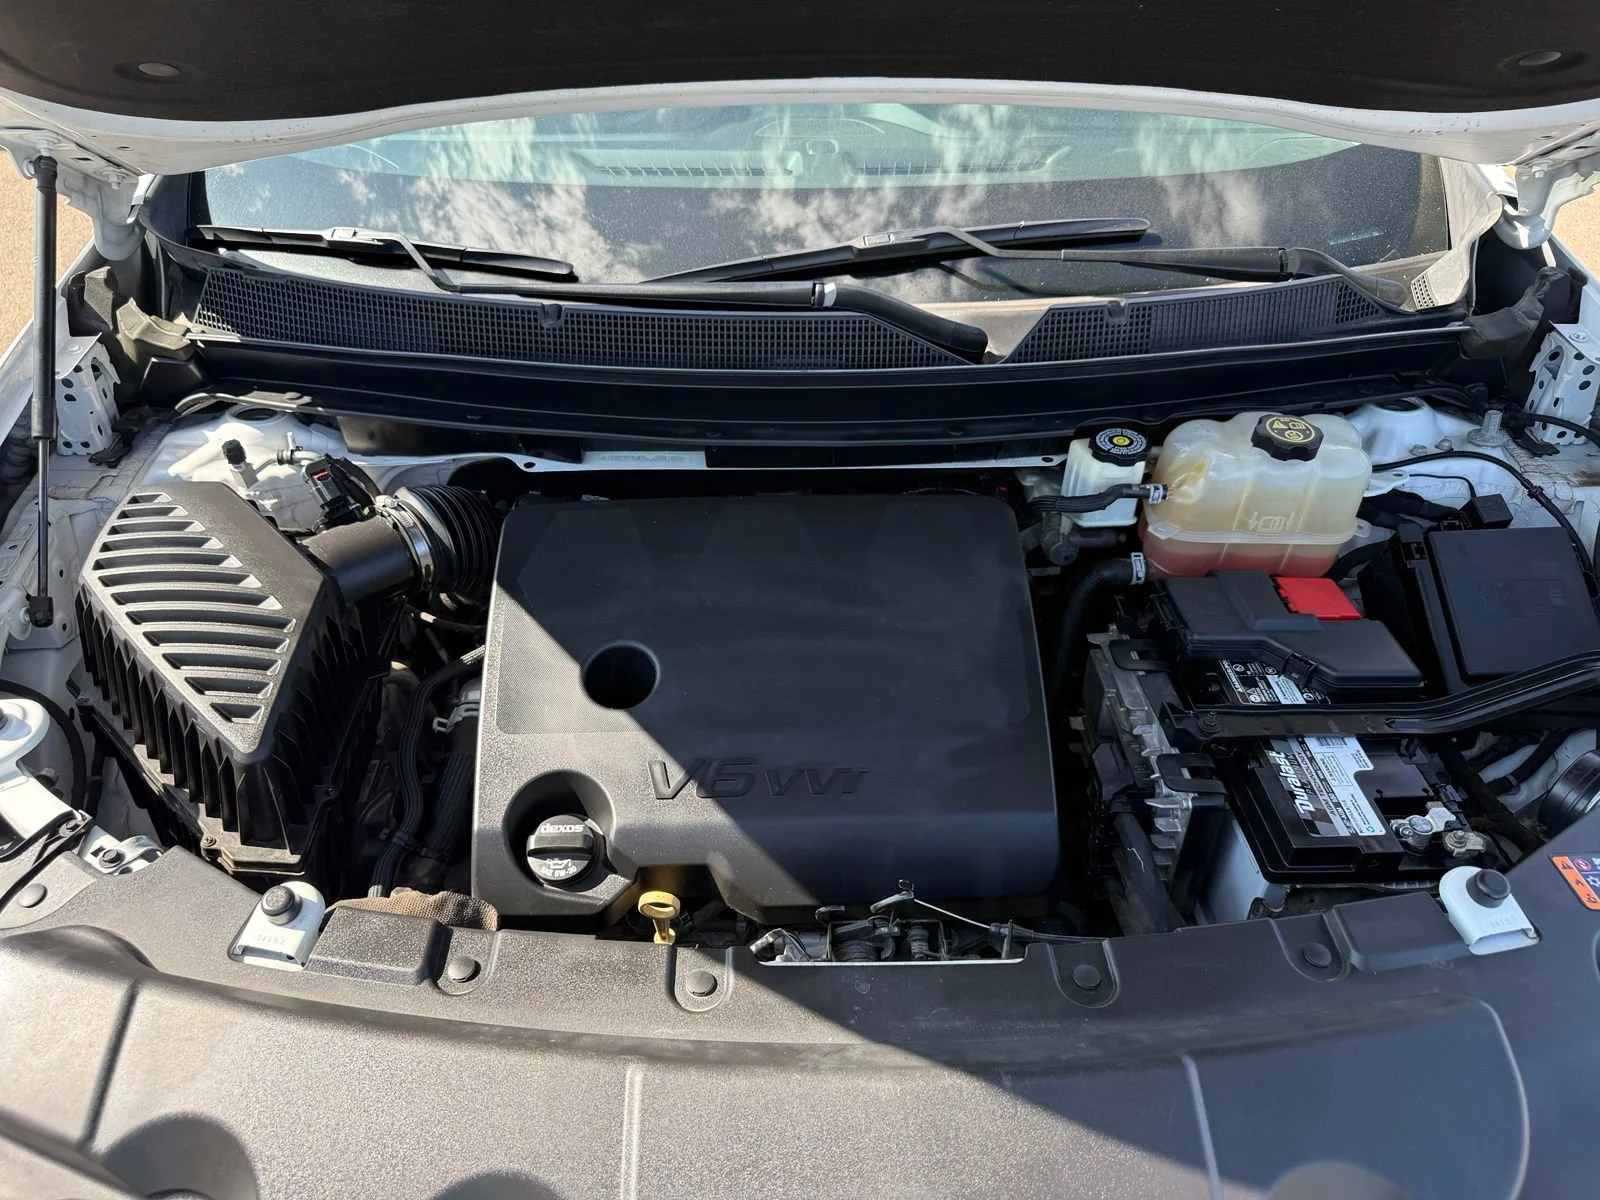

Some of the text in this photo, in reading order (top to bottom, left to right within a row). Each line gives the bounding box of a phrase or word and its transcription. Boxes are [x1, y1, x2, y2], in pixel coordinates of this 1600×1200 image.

[648, 757, 871, 800] V6 VVT
[1268, 750, 1316, 814] Duralast
[1295, 750, 1326, 797] TECHNOLOGY
[1320, 797, 1336, 816] AGM
[540, 823, 585, 834] dexos
